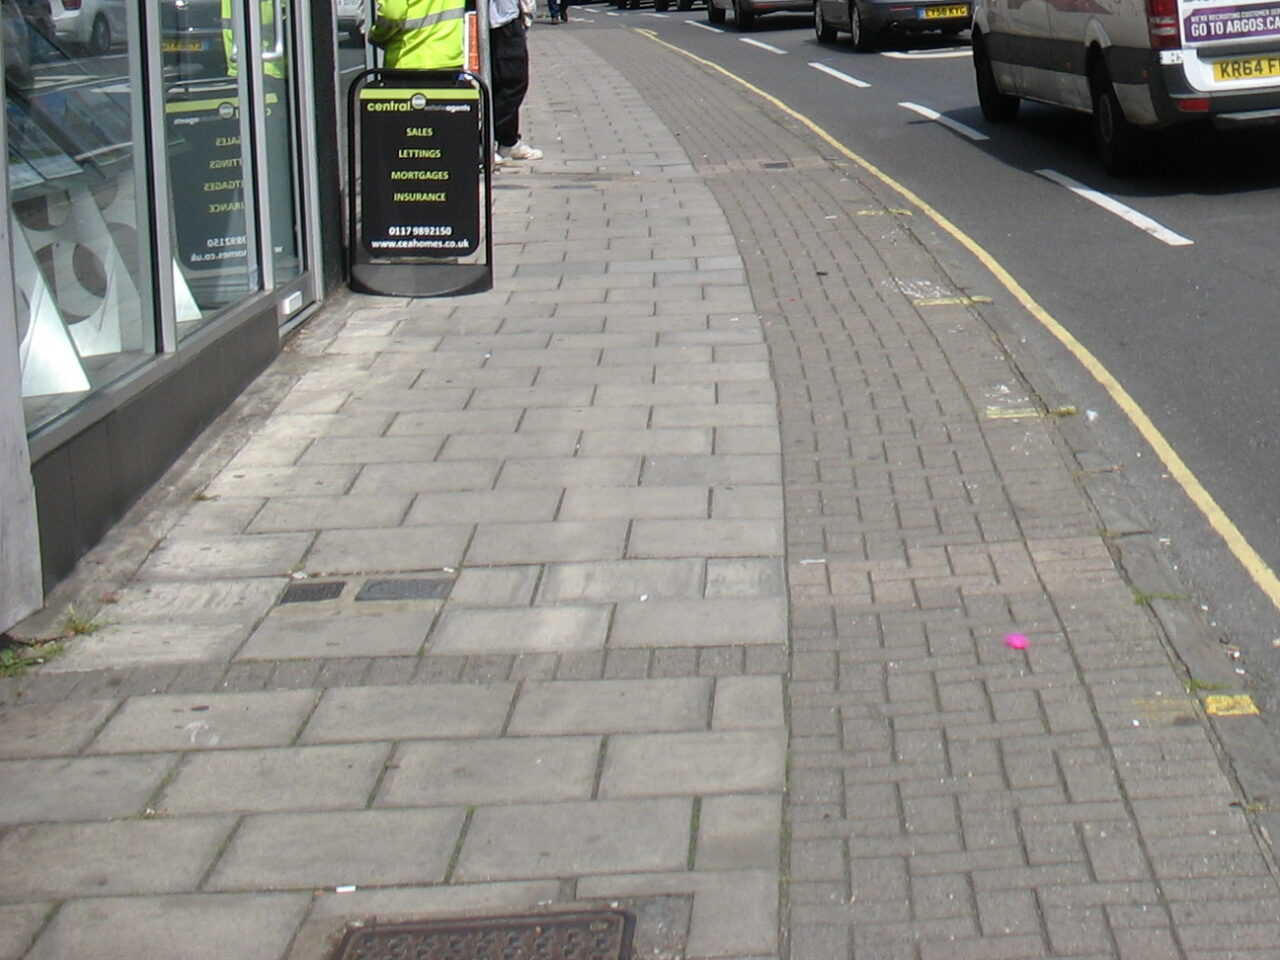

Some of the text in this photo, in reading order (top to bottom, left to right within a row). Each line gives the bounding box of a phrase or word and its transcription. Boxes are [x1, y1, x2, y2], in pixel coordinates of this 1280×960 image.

[1191, 24, 1207, 37] GO
[1210, 22, 1224, 35] TO
[1220, 60, 1263, 79] KR64
[406, 128, 433, 136] SALES
[398, 150, 441, 158] LETTINGS
[391, 171, 449, 180] MORTGAGES
[394, 193, 446, 202] INSURANCE
[389, 226, 452, 236] 0117 9892150
[371, 239, 470, 248] www.ceahomes.co.uk
